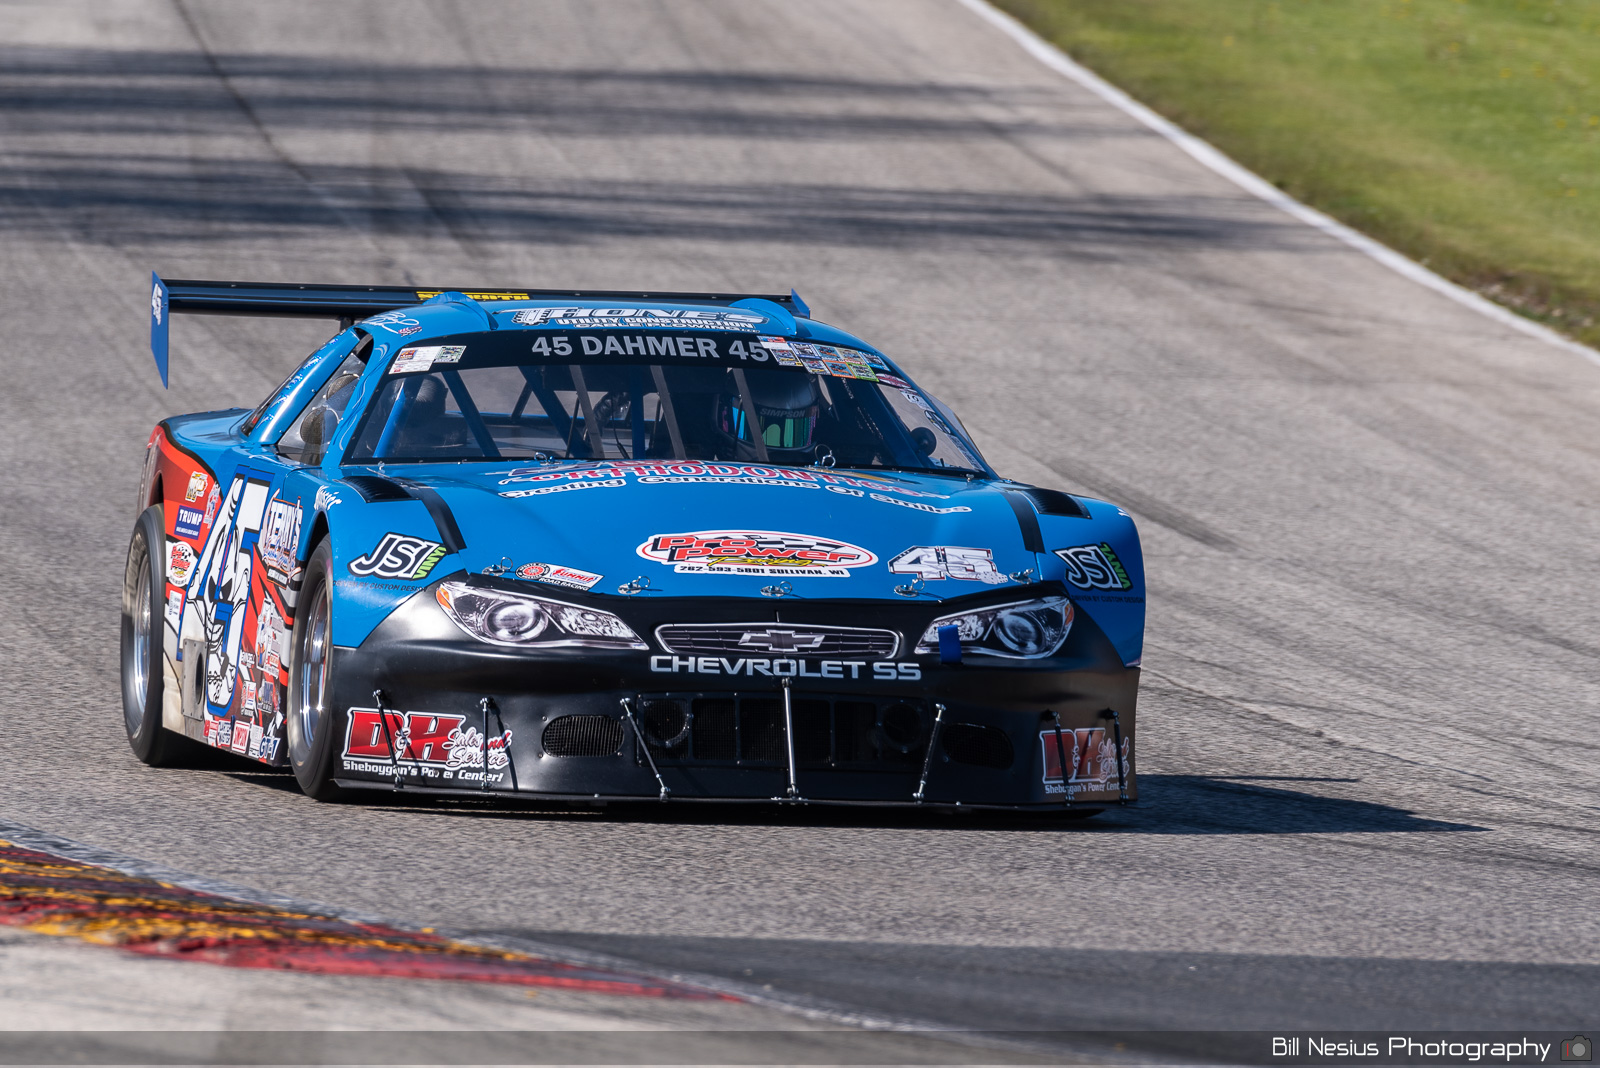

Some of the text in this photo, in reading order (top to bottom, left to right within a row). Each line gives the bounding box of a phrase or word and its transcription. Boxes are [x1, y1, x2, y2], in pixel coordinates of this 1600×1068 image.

[622, 317, 757, 329] CONSTRUCTION
[531, 336, 573, 357] 45
[580, 335, 720, 359] DAHMER
[728, 340, 770, 363] 45
[760, 408, 806, 418] SIMPSON
[499, 478, 627, 499] Creating
[637, 475, 821, 490] Generations
[825, 484, 865, 498] Of
[178, 508, 204, 526] TRUMP
[651, 536, 757, 550] Pro
[887, 545, 1003, 584] 45
[552, 568, 594, 582] SUMMIT
[369, 582, 400, 591] CUSTOM
[538, 576, 561, 586] ROAD
[560, 580, 590, 591] RACING
[650, 655, 922, 680] CHEVROLET SS
[441, 727, 484, 750] Sales
[446, 747, 509, 768] Service
[457, 769, 504, 782] Center!
[1044, 782, 1087, 795] Shebgan's
